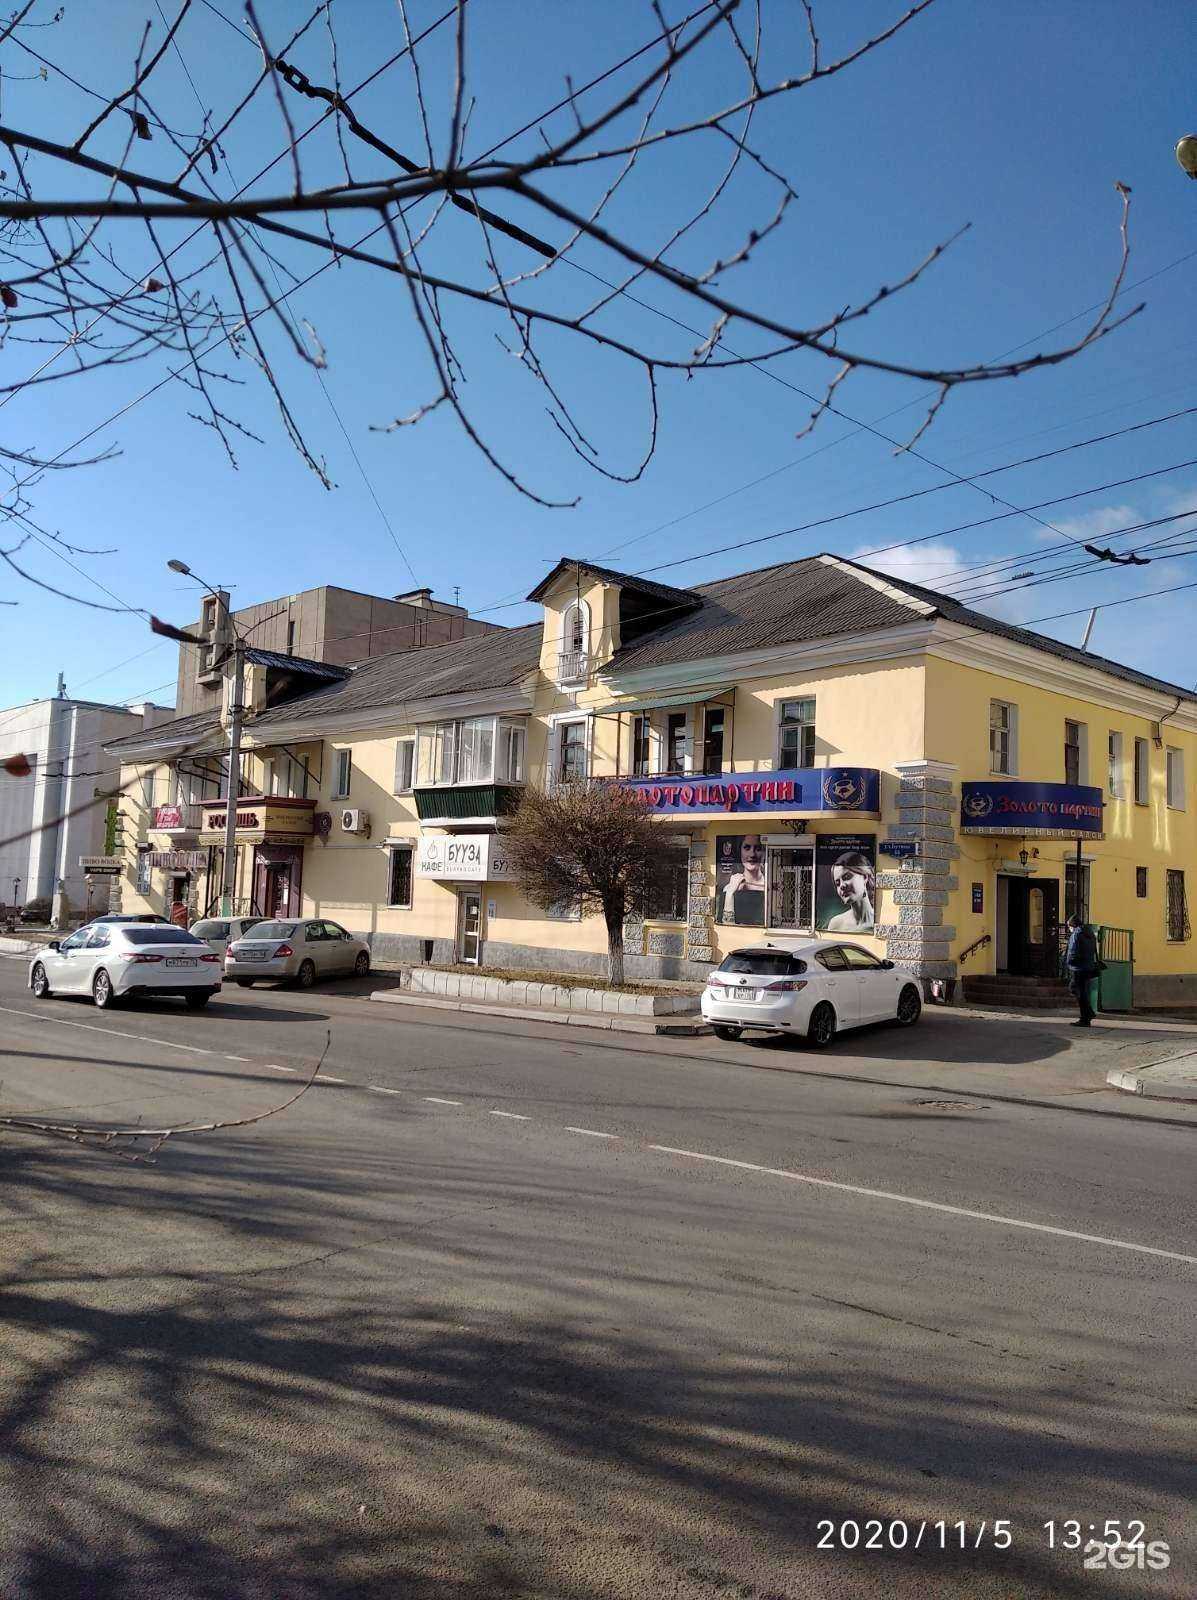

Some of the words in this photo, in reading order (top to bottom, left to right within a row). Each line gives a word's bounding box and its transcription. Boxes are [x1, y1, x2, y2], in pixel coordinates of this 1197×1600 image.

[208, 813, 259, 829] РОСШЬ
[964, 826, 1065, 837] ЮВЕЛИРНЫЙ
[421, 861, 443, 872] КАФЕ
